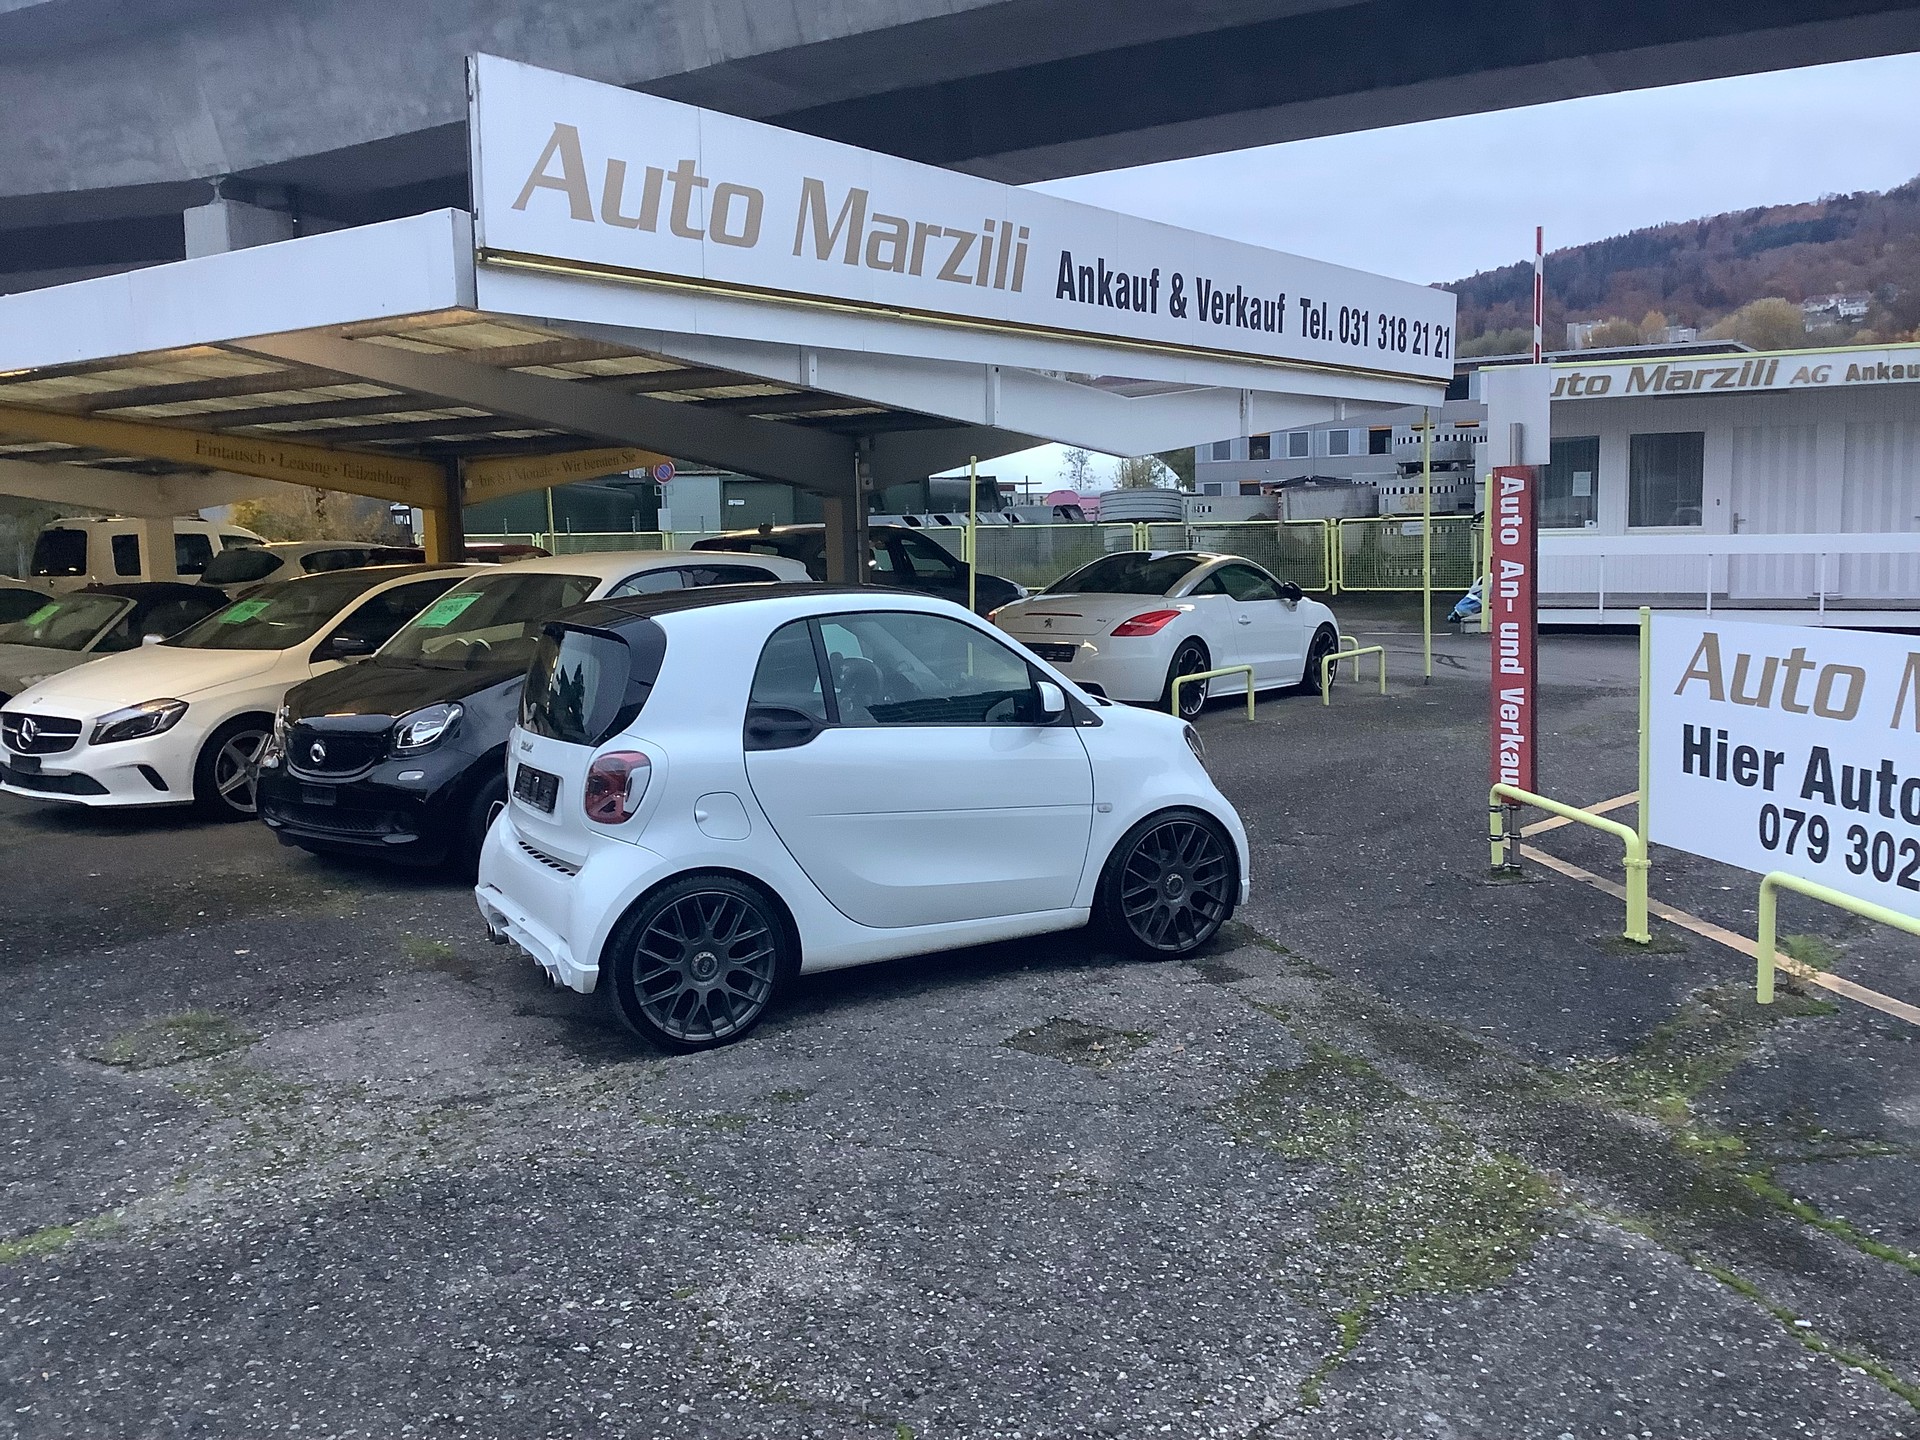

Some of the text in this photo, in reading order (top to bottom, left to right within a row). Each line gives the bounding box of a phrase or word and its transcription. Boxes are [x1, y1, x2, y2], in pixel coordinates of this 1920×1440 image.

[511, 122, 1030, 292] Auto Marzili
[1056, 250, 1451, 360] Ankauf & Verkauf Tel. 031 318 21 21
[1625, 359, 1780, 393] Marzili
[1789, 364, 1832, 385] AG
[195, 439, 412, 489] Eintausch Leasing Teilzahlung
[561, 459, 582, 473] Wir
[1500, 476, 1525, 789] Auto An- und Verkau
[1674, 632, 1866, 721] Auto
[1682, 723, 1785, 791] Hier
[1759, 803, 1920, 892] 079 302
